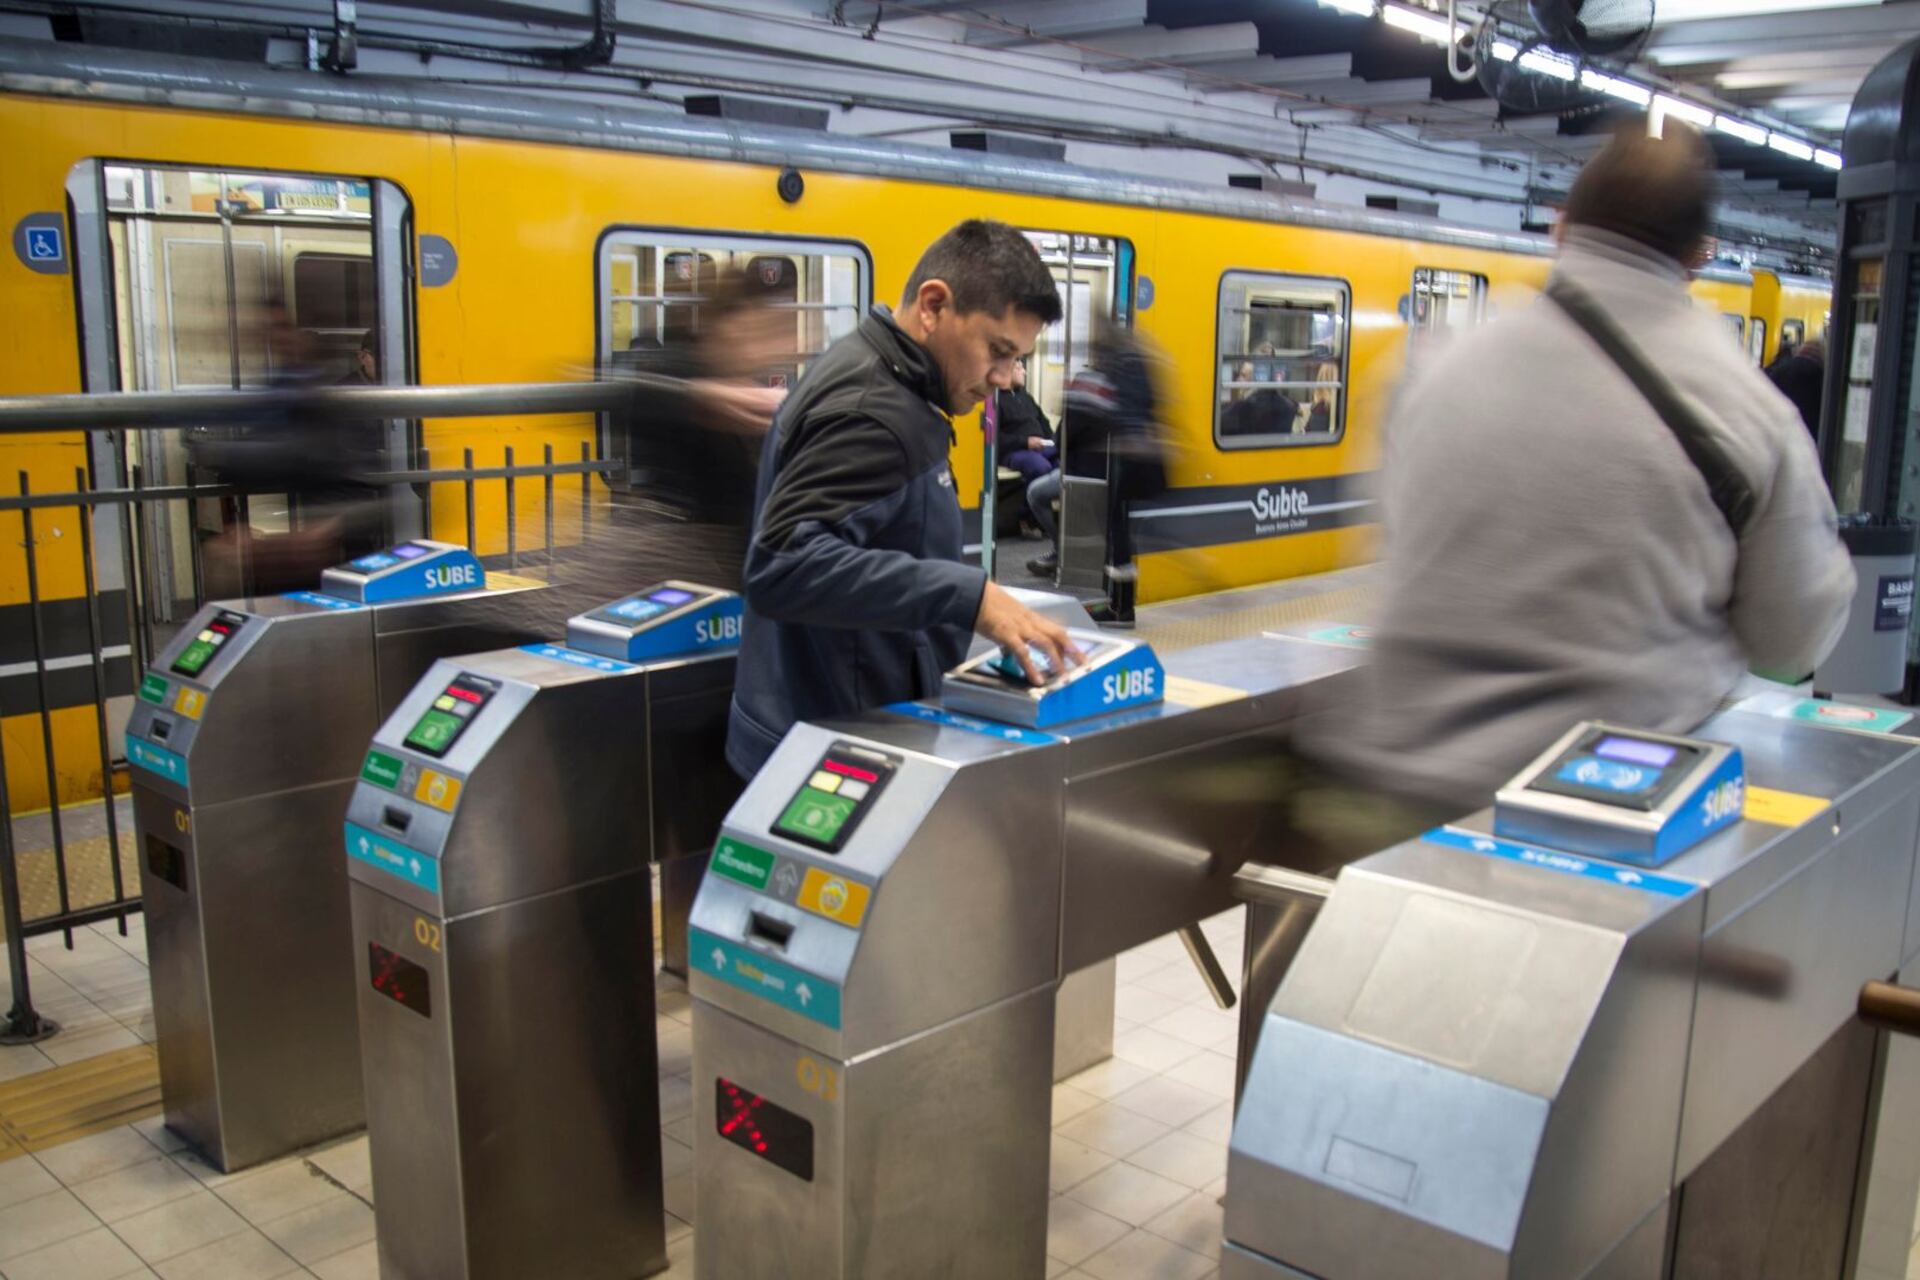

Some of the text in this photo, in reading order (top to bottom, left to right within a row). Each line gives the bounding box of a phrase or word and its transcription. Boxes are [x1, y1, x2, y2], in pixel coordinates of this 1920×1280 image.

[1256, 485, 1309, 520] Subte
[424, 564, 476, 590] SUBE
[1102, 666, 1155, 705] SUBE
[1702, 776, 1743, 828] SUBE
[175, 809, 192, 835] 01
[415, 917, 440, 952] 02
